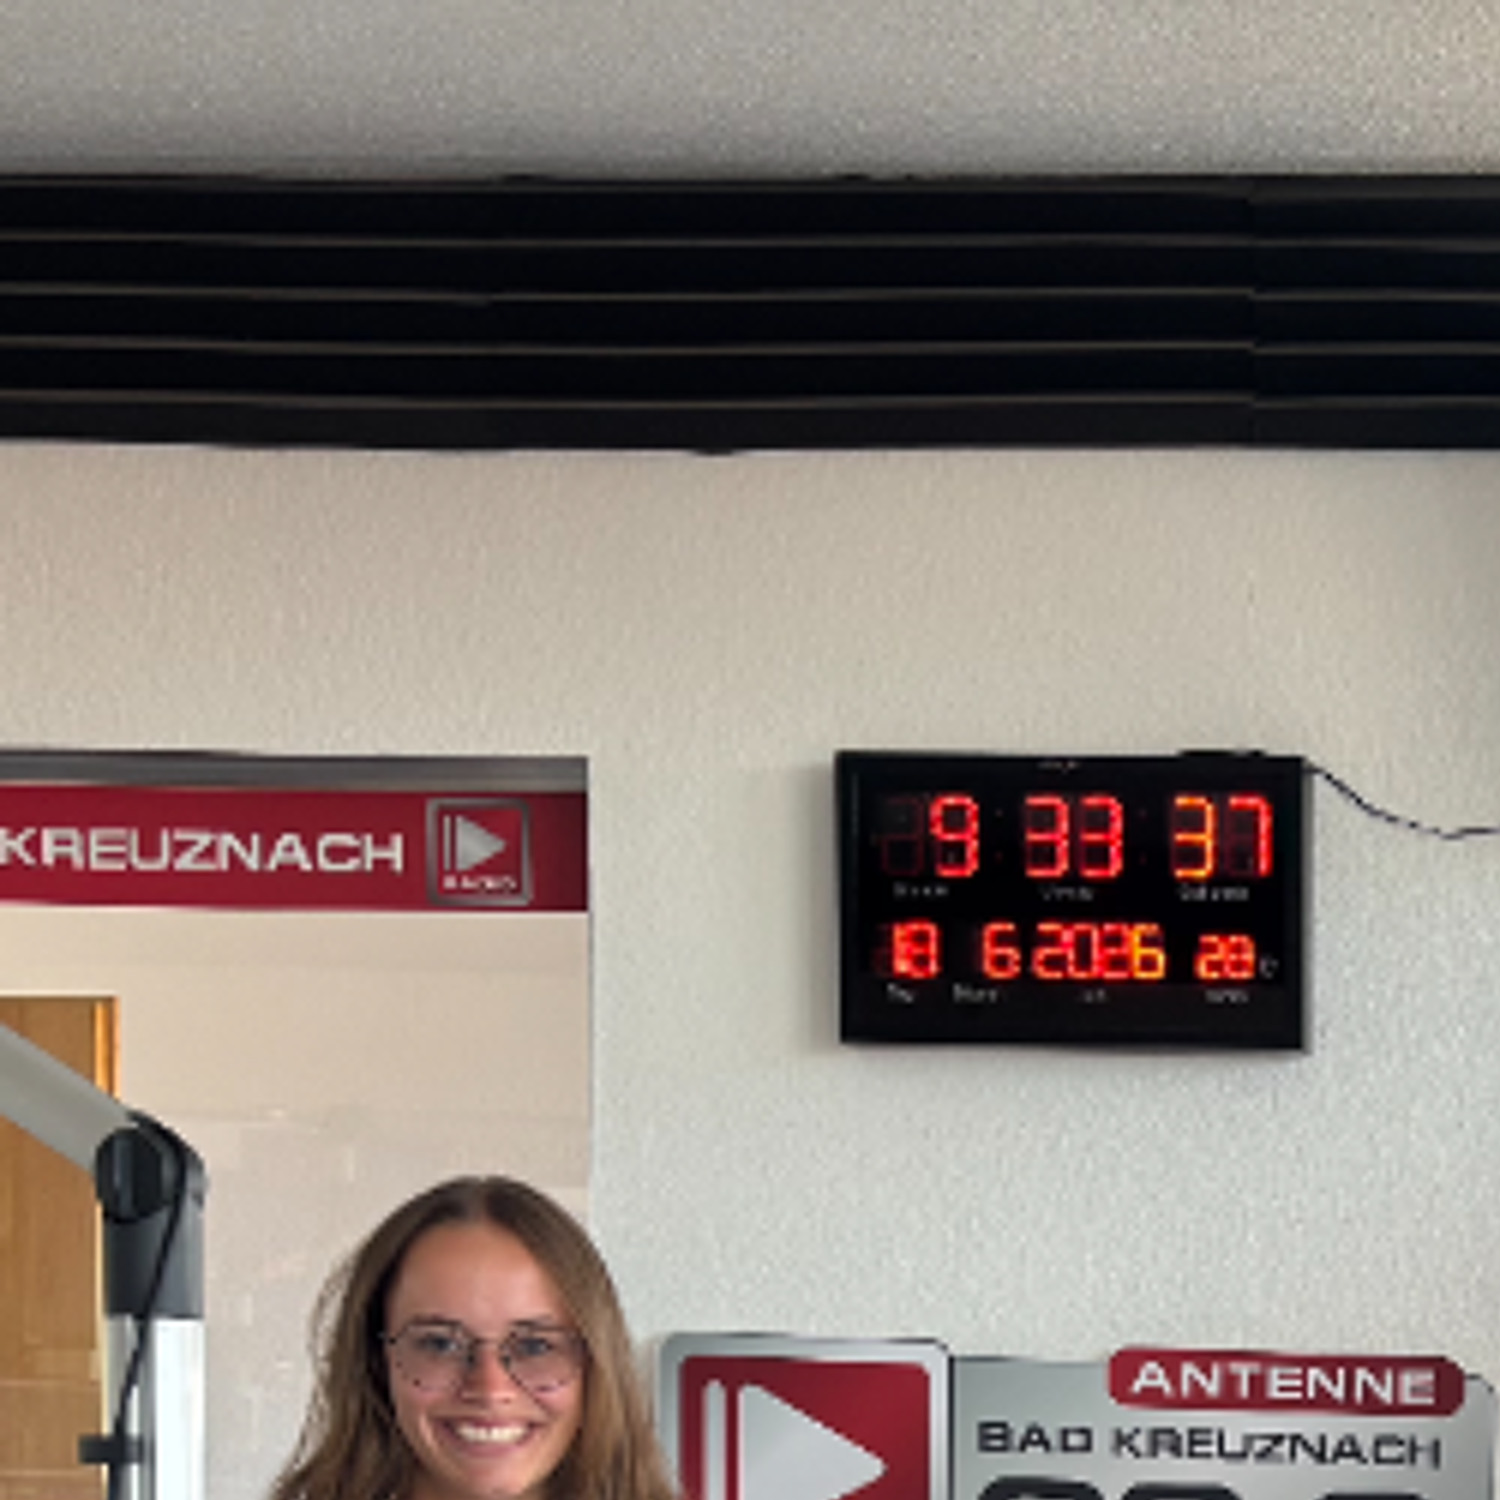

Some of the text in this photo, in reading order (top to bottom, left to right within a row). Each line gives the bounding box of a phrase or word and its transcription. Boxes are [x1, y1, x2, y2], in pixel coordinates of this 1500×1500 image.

[0, 827, 405, 874] KREUZNACH
[930, 791, 1273, 878] 9 33 37
[1130, 1360, 1437, 1404] ANTENNE
[977, 1422, 1442, 1469] BAD KREUZNACH
